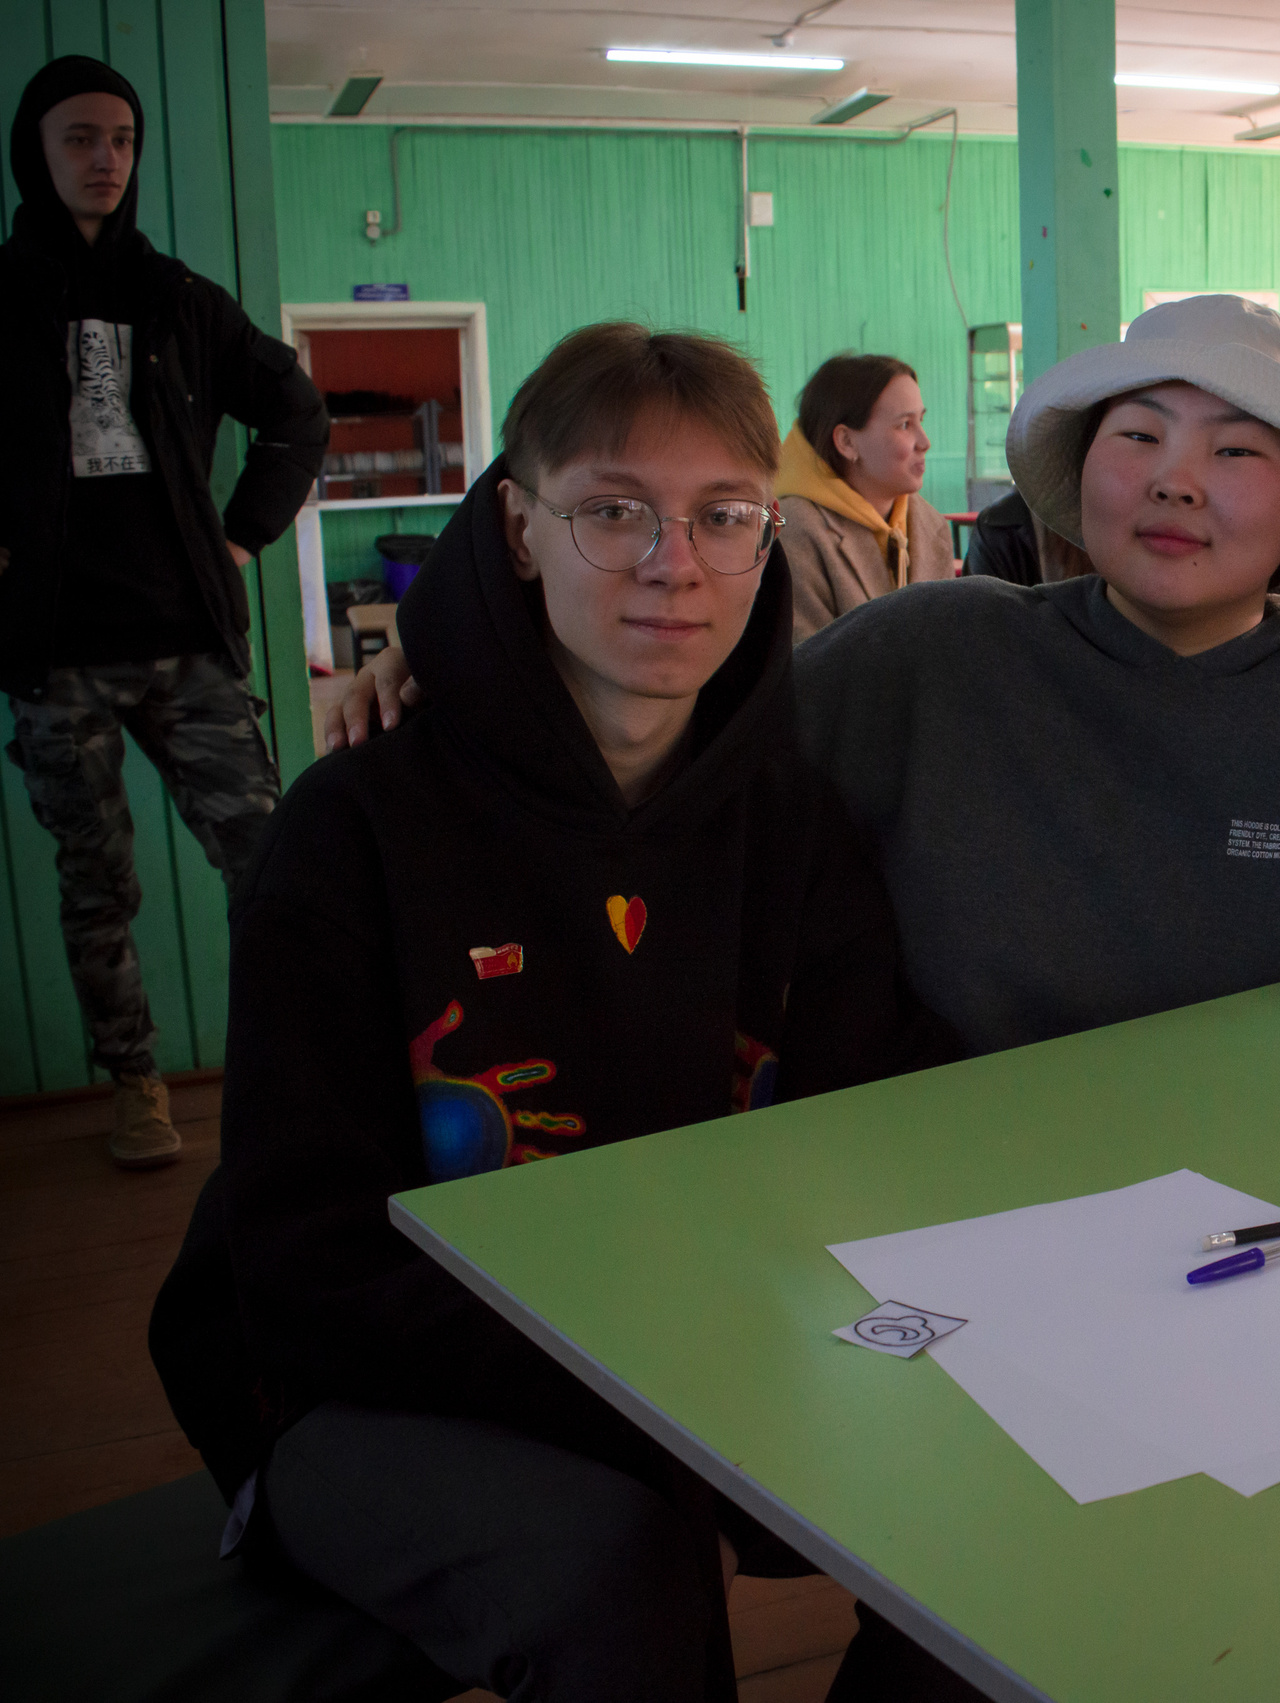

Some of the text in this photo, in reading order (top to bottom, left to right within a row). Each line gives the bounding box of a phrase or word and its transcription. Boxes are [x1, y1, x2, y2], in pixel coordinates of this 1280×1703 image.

[1231, 819, 1243, 827] THIS
[1243, 820, 1263, 830] HOODIE
[1229, 829, 1255, 839] FRIENDLY
[1251, 841, 1261, 849] THE
[1262, 842, 1280, 850] FABRIC
[1227, 848, 1251, 857] ORGANIC
[1252, 850, 1272, 859] COTTON
